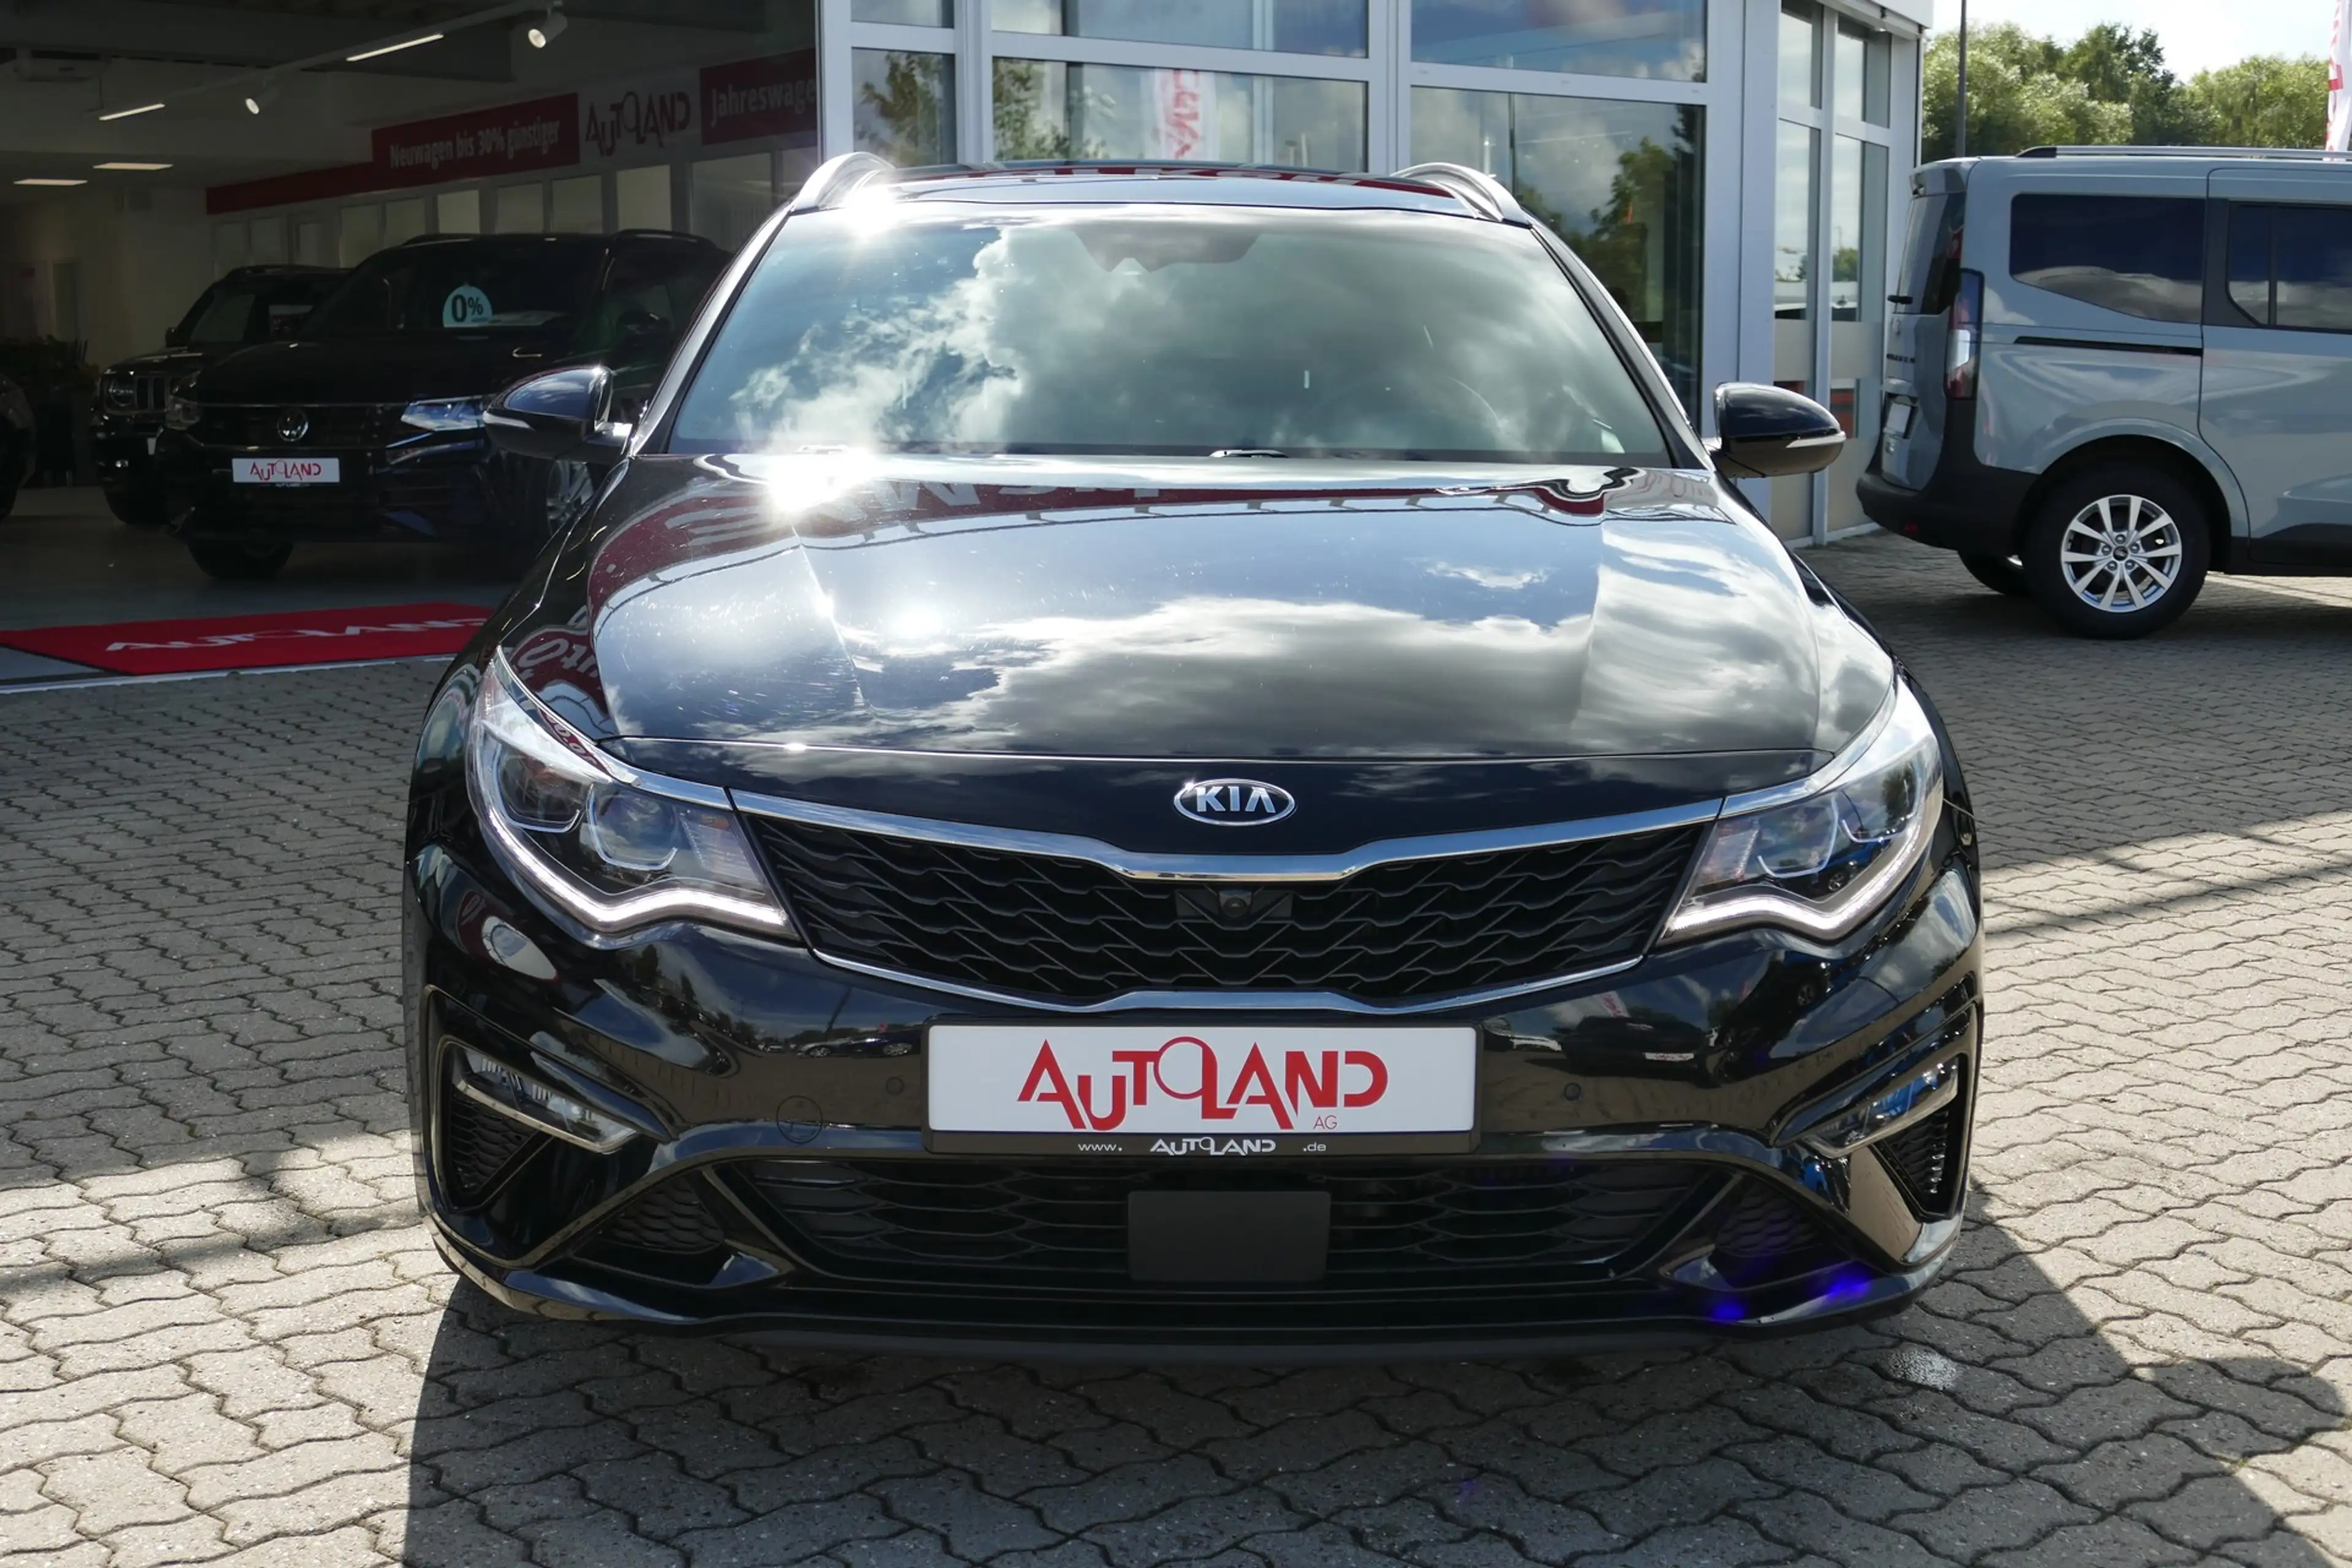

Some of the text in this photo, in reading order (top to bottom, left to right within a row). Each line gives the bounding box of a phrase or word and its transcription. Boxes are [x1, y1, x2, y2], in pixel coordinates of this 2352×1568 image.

[586, 91, 690, 156] AUTOLAND
[390, 116, 560, 169] Neuwagen bis 30% günstiger
[452, 294, 483, 323] 0%
[250, 460, 321, 480] AUTOLAND
[1195, 786, 1276, 813] KIA
[1017, 1036, 1389, 1131] AUTOLAND
[1313, 1115, 1338, 1130] AG
[1078, 1137, 1327, 1156] www. AUTOLAND .de
